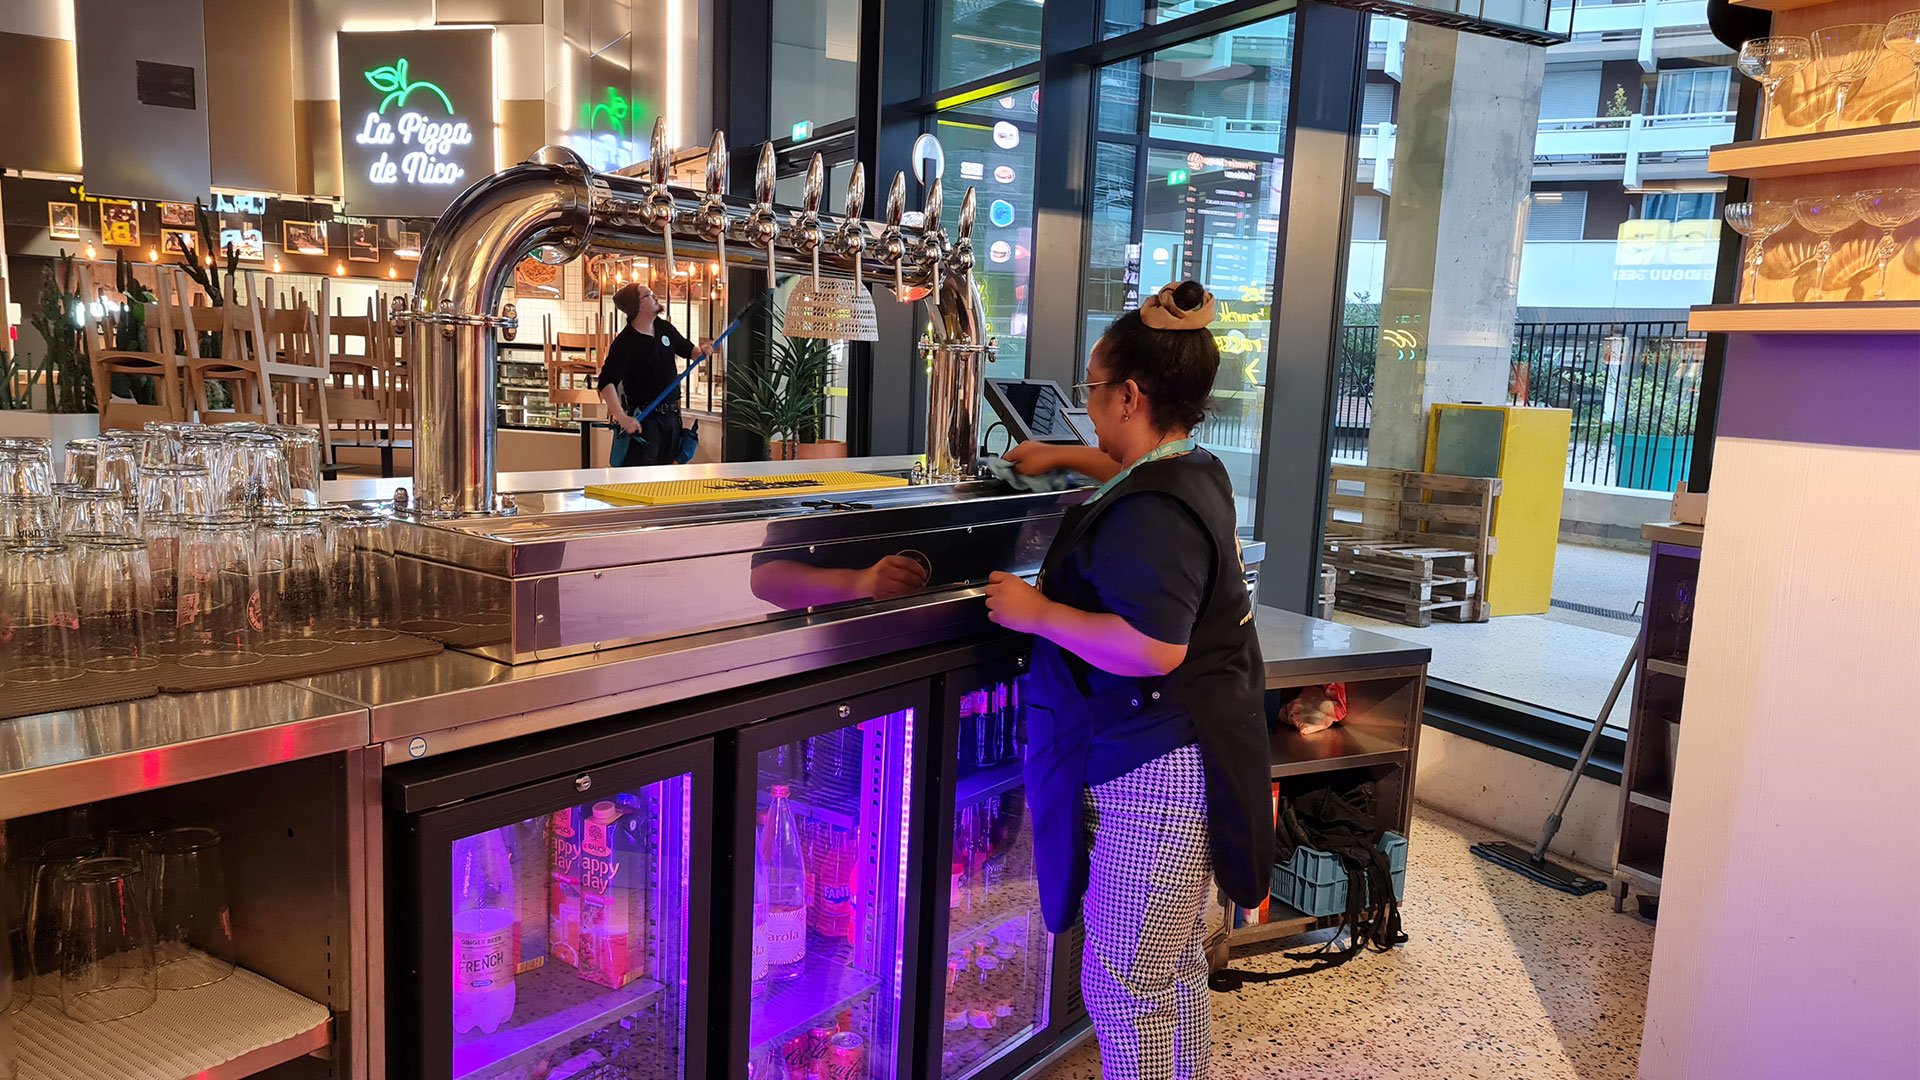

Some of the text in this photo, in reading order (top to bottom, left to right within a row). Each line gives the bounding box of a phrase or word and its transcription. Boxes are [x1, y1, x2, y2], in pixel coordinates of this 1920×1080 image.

[356, 112, 472, 154] La Pizza
[369, 152, 464, 183] de Nico
[552, 837, 579, 860] appy
[588, 844, 607, 853] RAUCH
[582, 856, 620, 880] appy
[582, 871, 608, 895] day
[824, 885, 850, 899] FANT
[461, 935, 502, 946] GINGER BEER
[767, 930, 799, 942] arola
[459, 951, 504, 975] FRENCH
